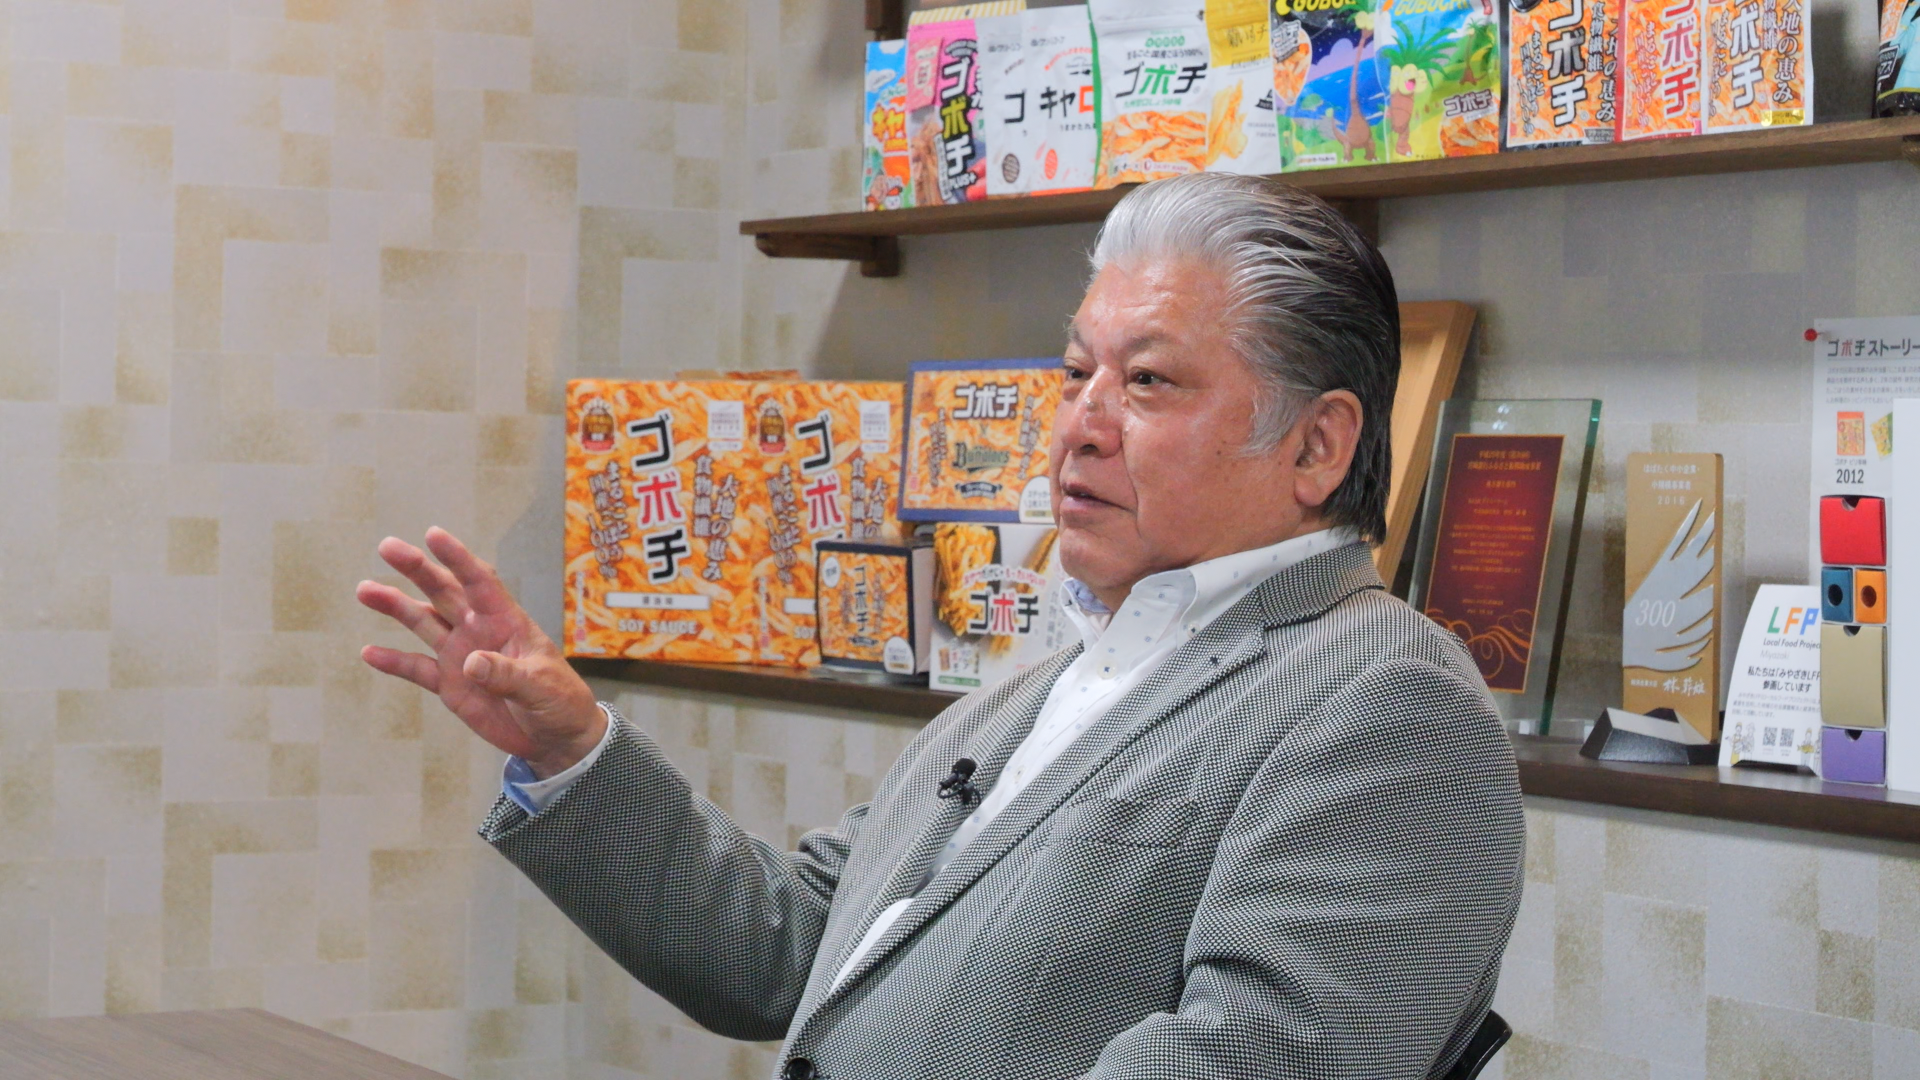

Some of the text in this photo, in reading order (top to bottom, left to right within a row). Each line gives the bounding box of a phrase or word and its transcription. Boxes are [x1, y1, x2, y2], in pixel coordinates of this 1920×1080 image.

[1730, 0, 1763, 108] ボチ
[1115, 62, 1208, 98] ゴボチ
[942, 56, 974, 177] ゴボチ
[1445, 90, 1493, 117] ゴボチ
[953, 383, 1018, 419] ゴボチ
[798, 413, 843, 540] ゴボ
[1836, 468, 1865, 484] 2012
[630, 412, 688, 580] ゴボチ
[618, 619, 698, 635] SOY SAUCE
[970, 590, 1039, 633] ゴボチ
[1635, 598, 1676, 628] 300
[1767, 606, 1820, 635] LFP
[1763, 637, 1781, 646] Local
[1781, 638, 1798, 648] Food
